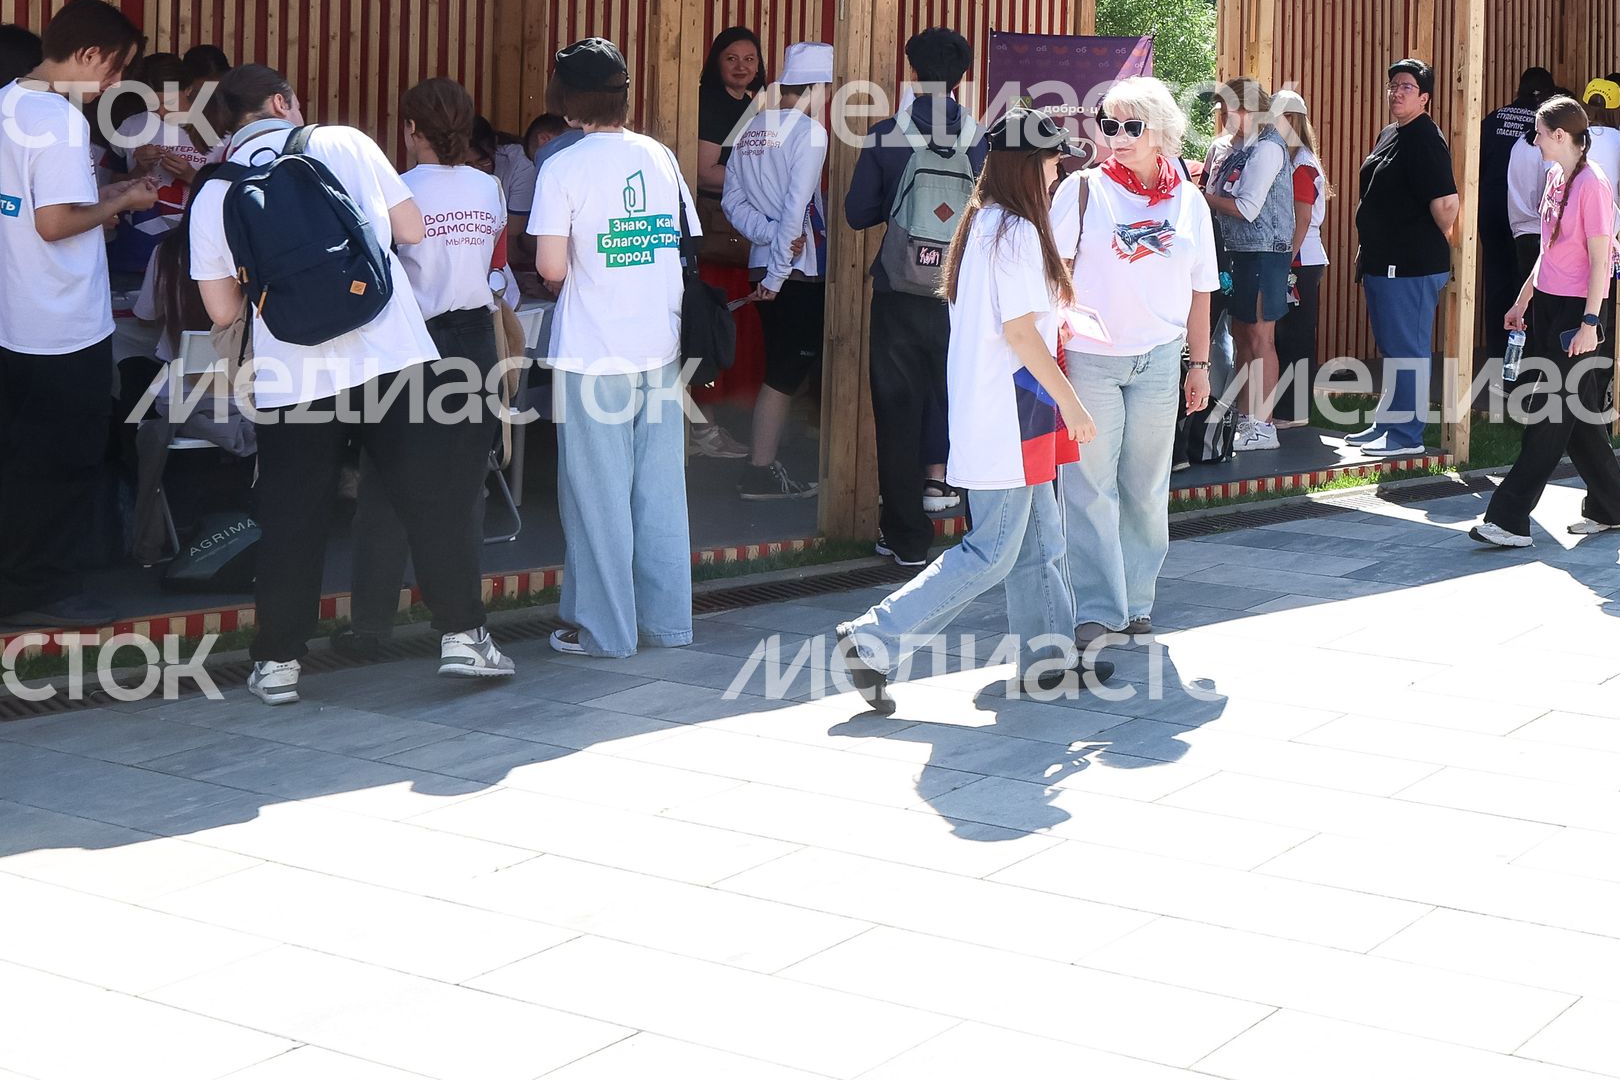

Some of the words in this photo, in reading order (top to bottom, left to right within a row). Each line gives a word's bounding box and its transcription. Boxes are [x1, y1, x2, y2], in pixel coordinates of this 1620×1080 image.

[613, 220, 651, 232] Знаю,
[609, 251, 652, 265] город
[189, 518, 257, 557] AGRIMA
